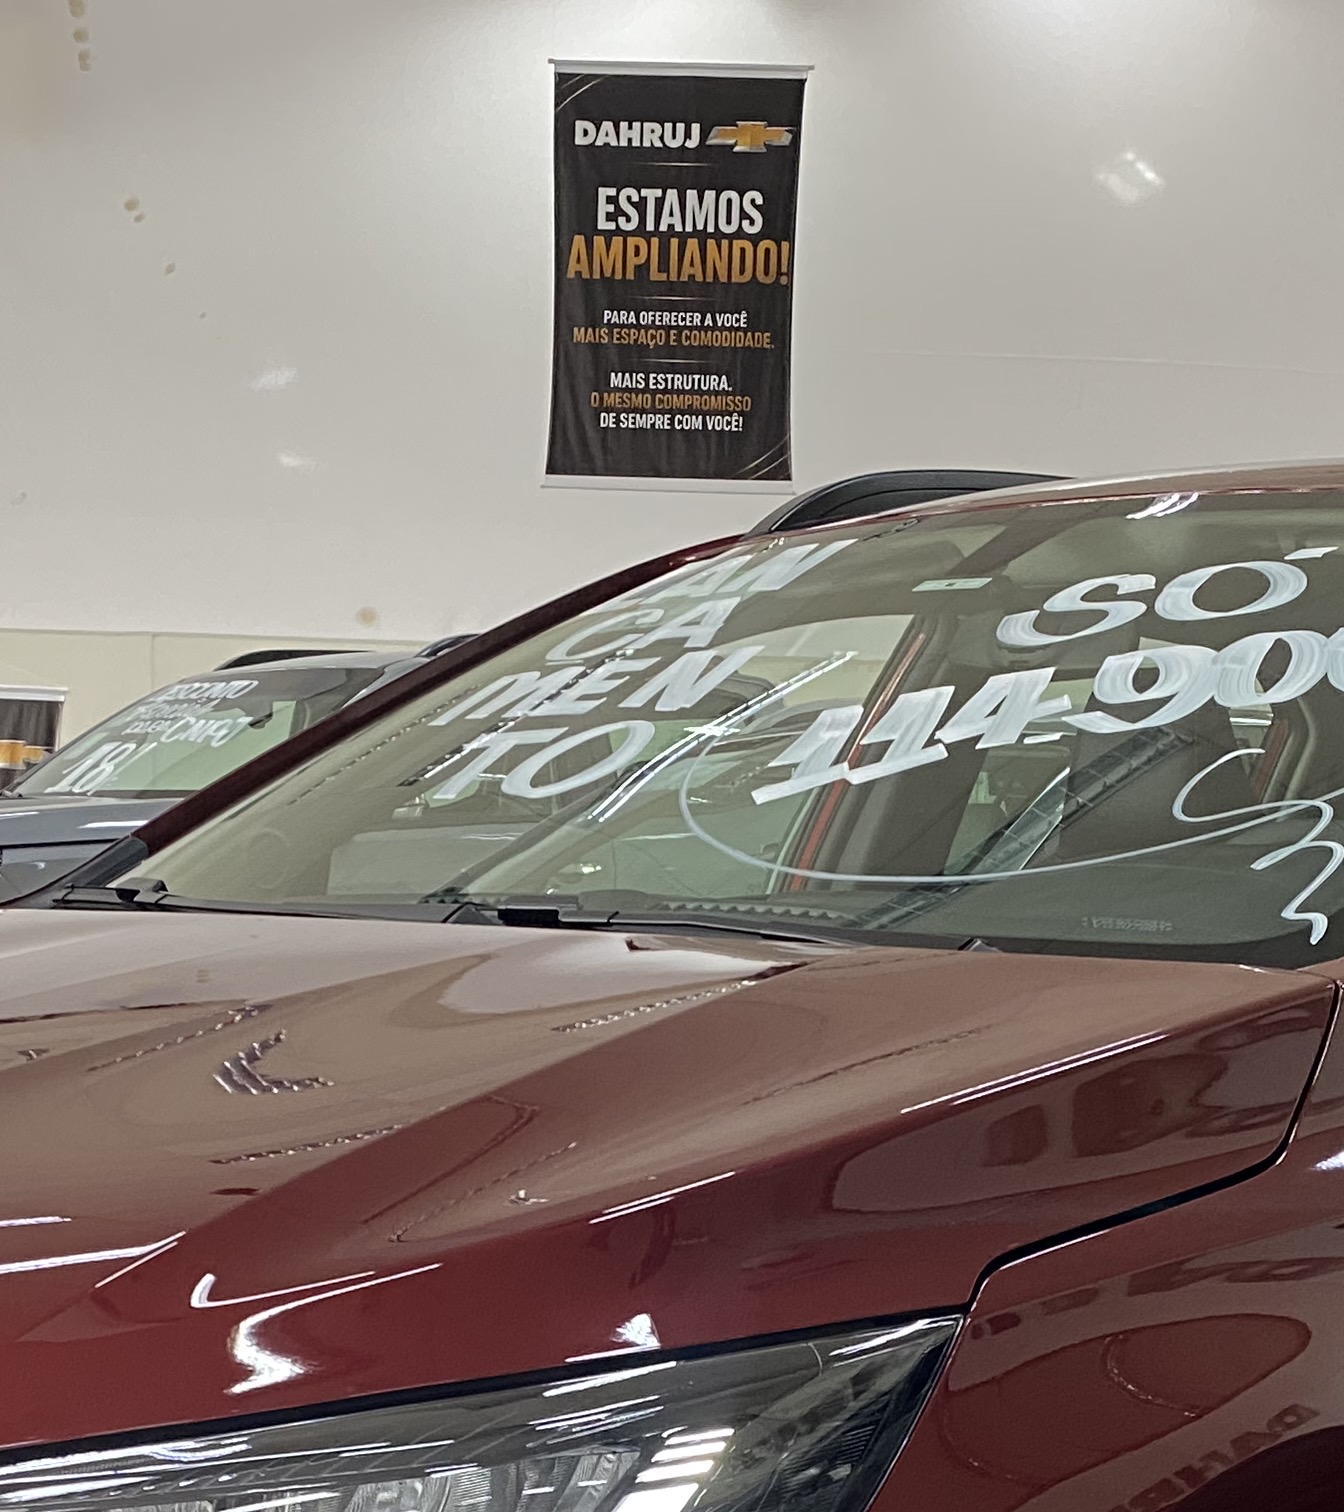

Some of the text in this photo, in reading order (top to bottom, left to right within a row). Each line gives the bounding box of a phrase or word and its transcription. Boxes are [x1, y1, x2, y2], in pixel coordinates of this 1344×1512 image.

[574, 119, 701, 148] DAHRUJ
[597, 187, 764, 234] ESTAMOS
[566, 234, 790, 286] AMPLIANDO!
[603, 310, 748, 328] PARA OFERECER A VOCÊ
[572, 327, 775, 349] MAIS ESPAÇO E COMODIDADE.
[609, 372, 733, 391] MAIS ESTRUTURA.
[590, 391, 752, 412] O MESMO COMPROMISSO
[599, 412, 744, 432] DE SEMPRE COM VOCÊ!
[995, 545, 1340, 648] SÓ
[432, 719, 656, 800] TO
